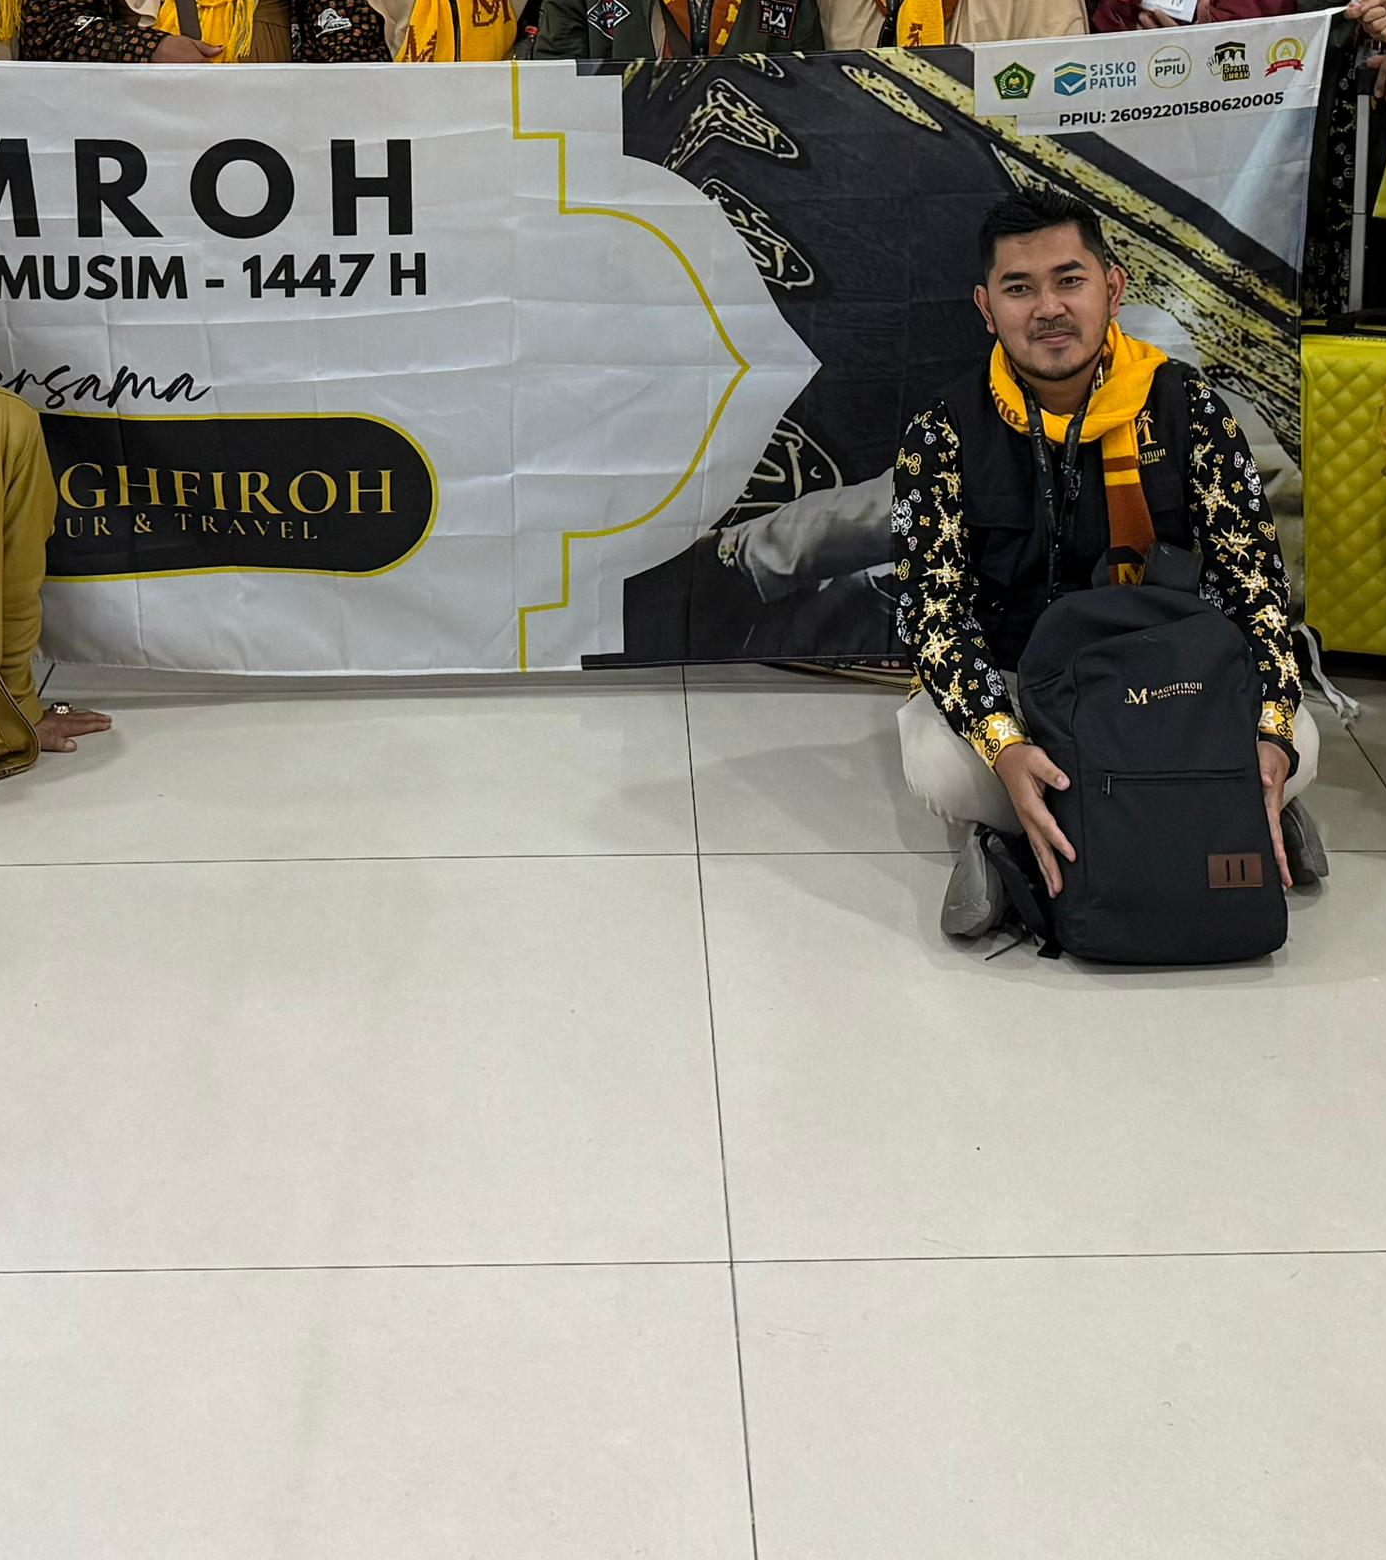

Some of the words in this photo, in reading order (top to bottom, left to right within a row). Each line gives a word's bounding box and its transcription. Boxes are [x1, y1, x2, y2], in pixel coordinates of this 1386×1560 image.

[1089, 73, 1137, 90] PATUH
[1154, 63, 1186, 78] PPIU
[1058, 111, 1107, 128] PPIU:
[1110, 91, 1284, 123] 26092201580620005
[241, 252, 374, 300] 1447
[391, 250, 428, 297] H
[59, 461, 397, 516] GHFIROH
[133, 514, 153, 535] &
[174, 512, 320, 541] TRAVEL
